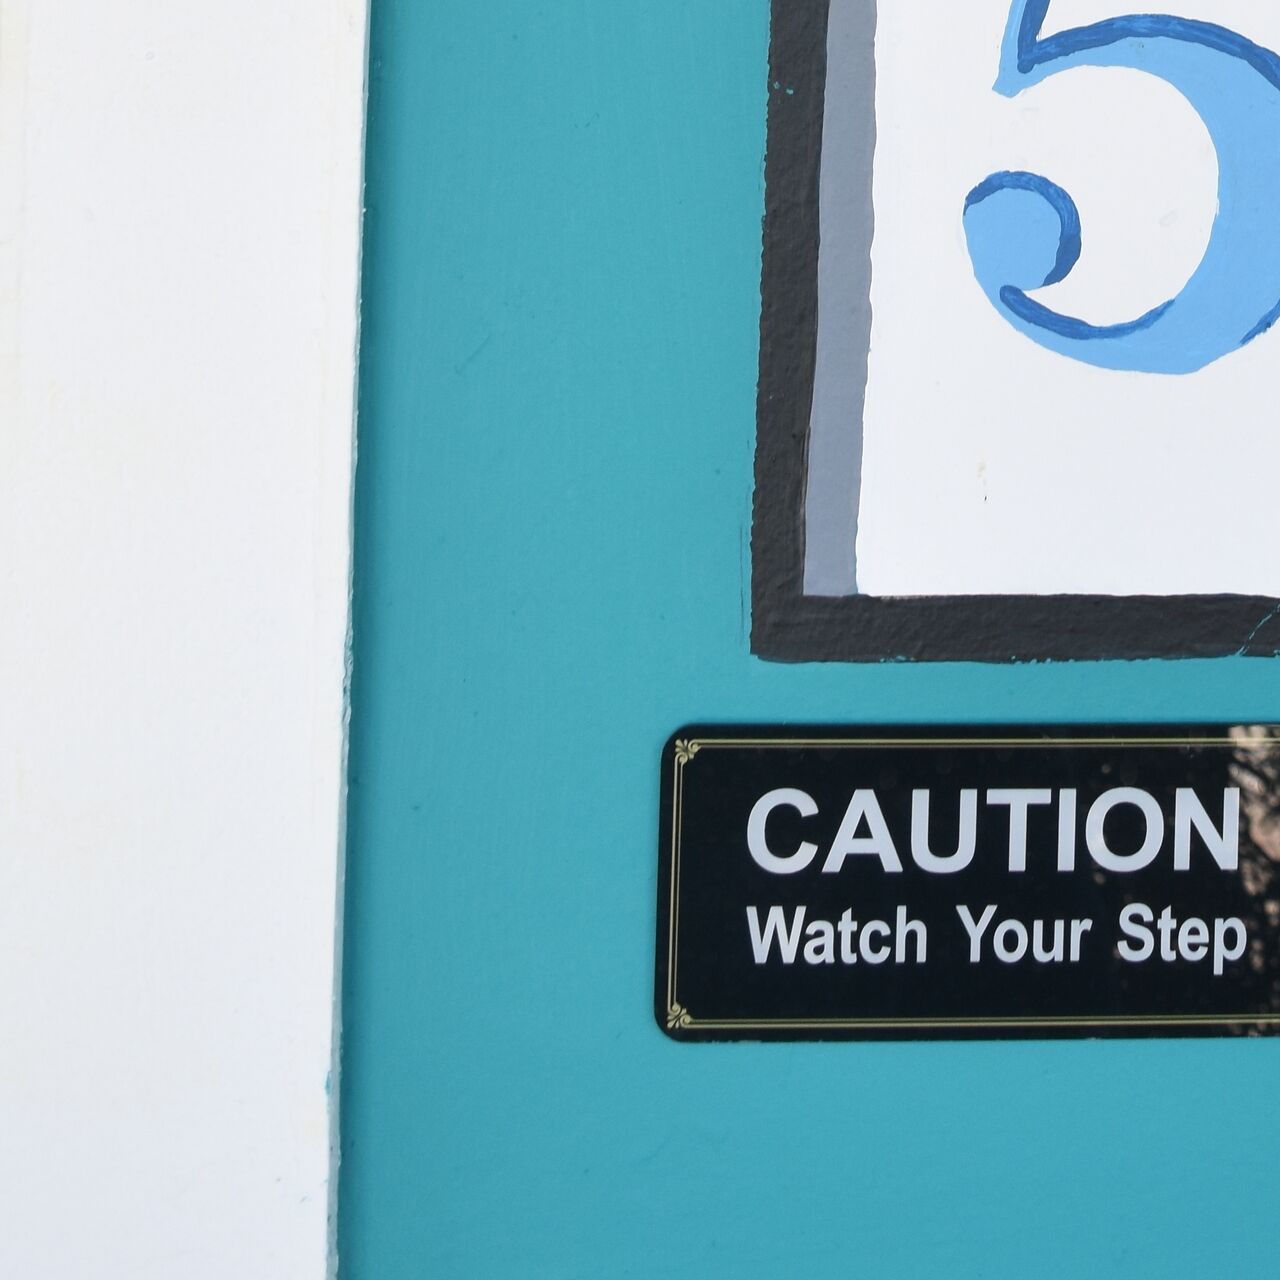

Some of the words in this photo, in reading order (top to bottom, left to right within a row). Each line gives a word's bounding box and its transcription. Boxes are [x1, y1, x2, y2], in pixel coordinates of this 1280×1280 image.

[747, 787, 1240, 874] CAUTION
[747, 905, 927, 965] Watch
[957, 905, 1092, 964] Your
[1118, 903, 1248, 976] Step
